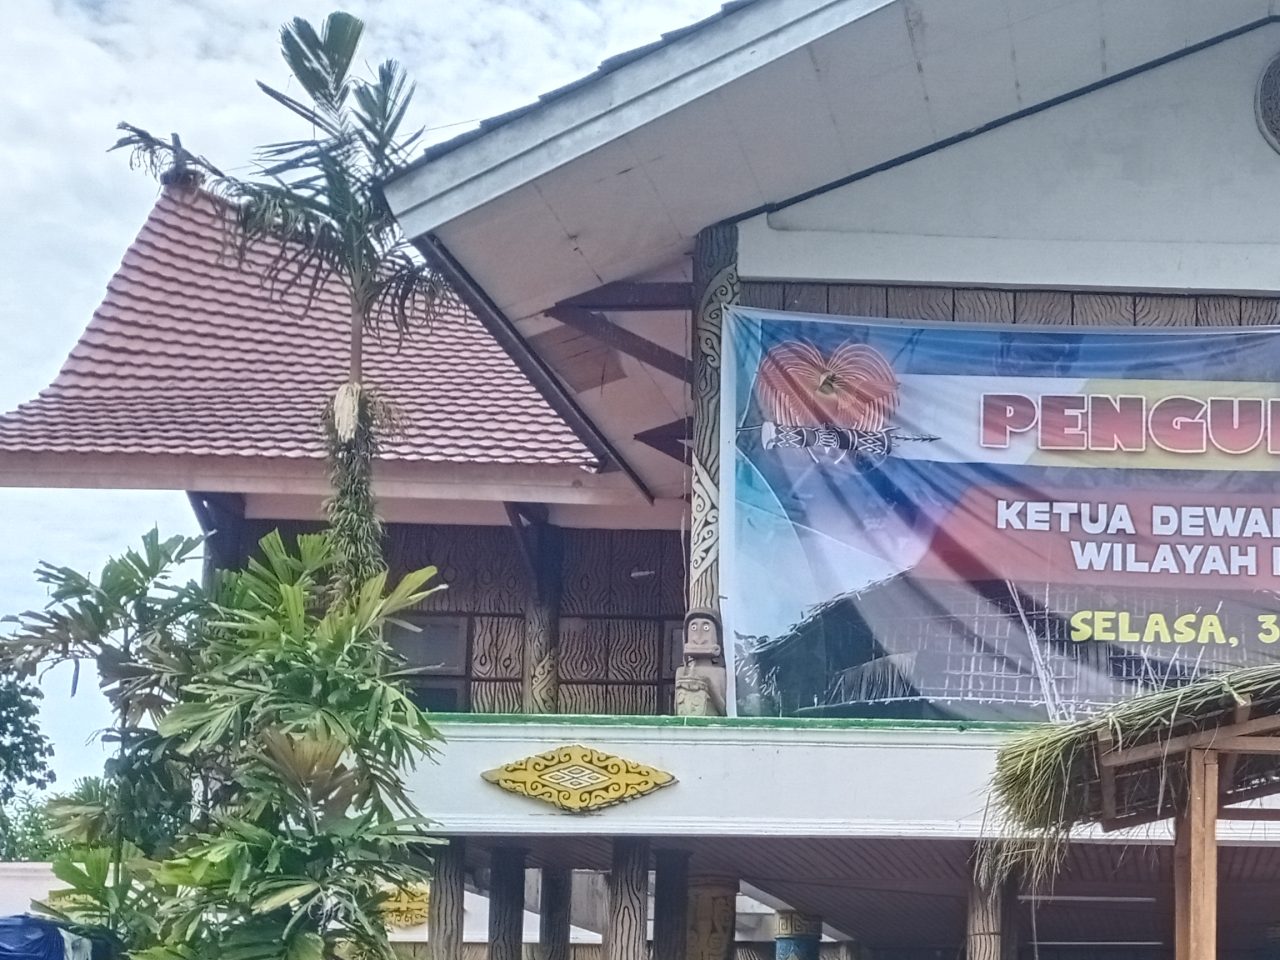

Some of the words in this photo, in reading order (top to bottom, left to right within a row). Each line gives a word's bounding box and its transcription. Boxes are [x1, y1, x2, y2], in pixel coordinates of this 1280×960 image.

[997, 499, 1137, 534] KETUA
[1070, 540, 1257, 576] WILAYAH
[1070, 610, 1240, 648] SELASA,
